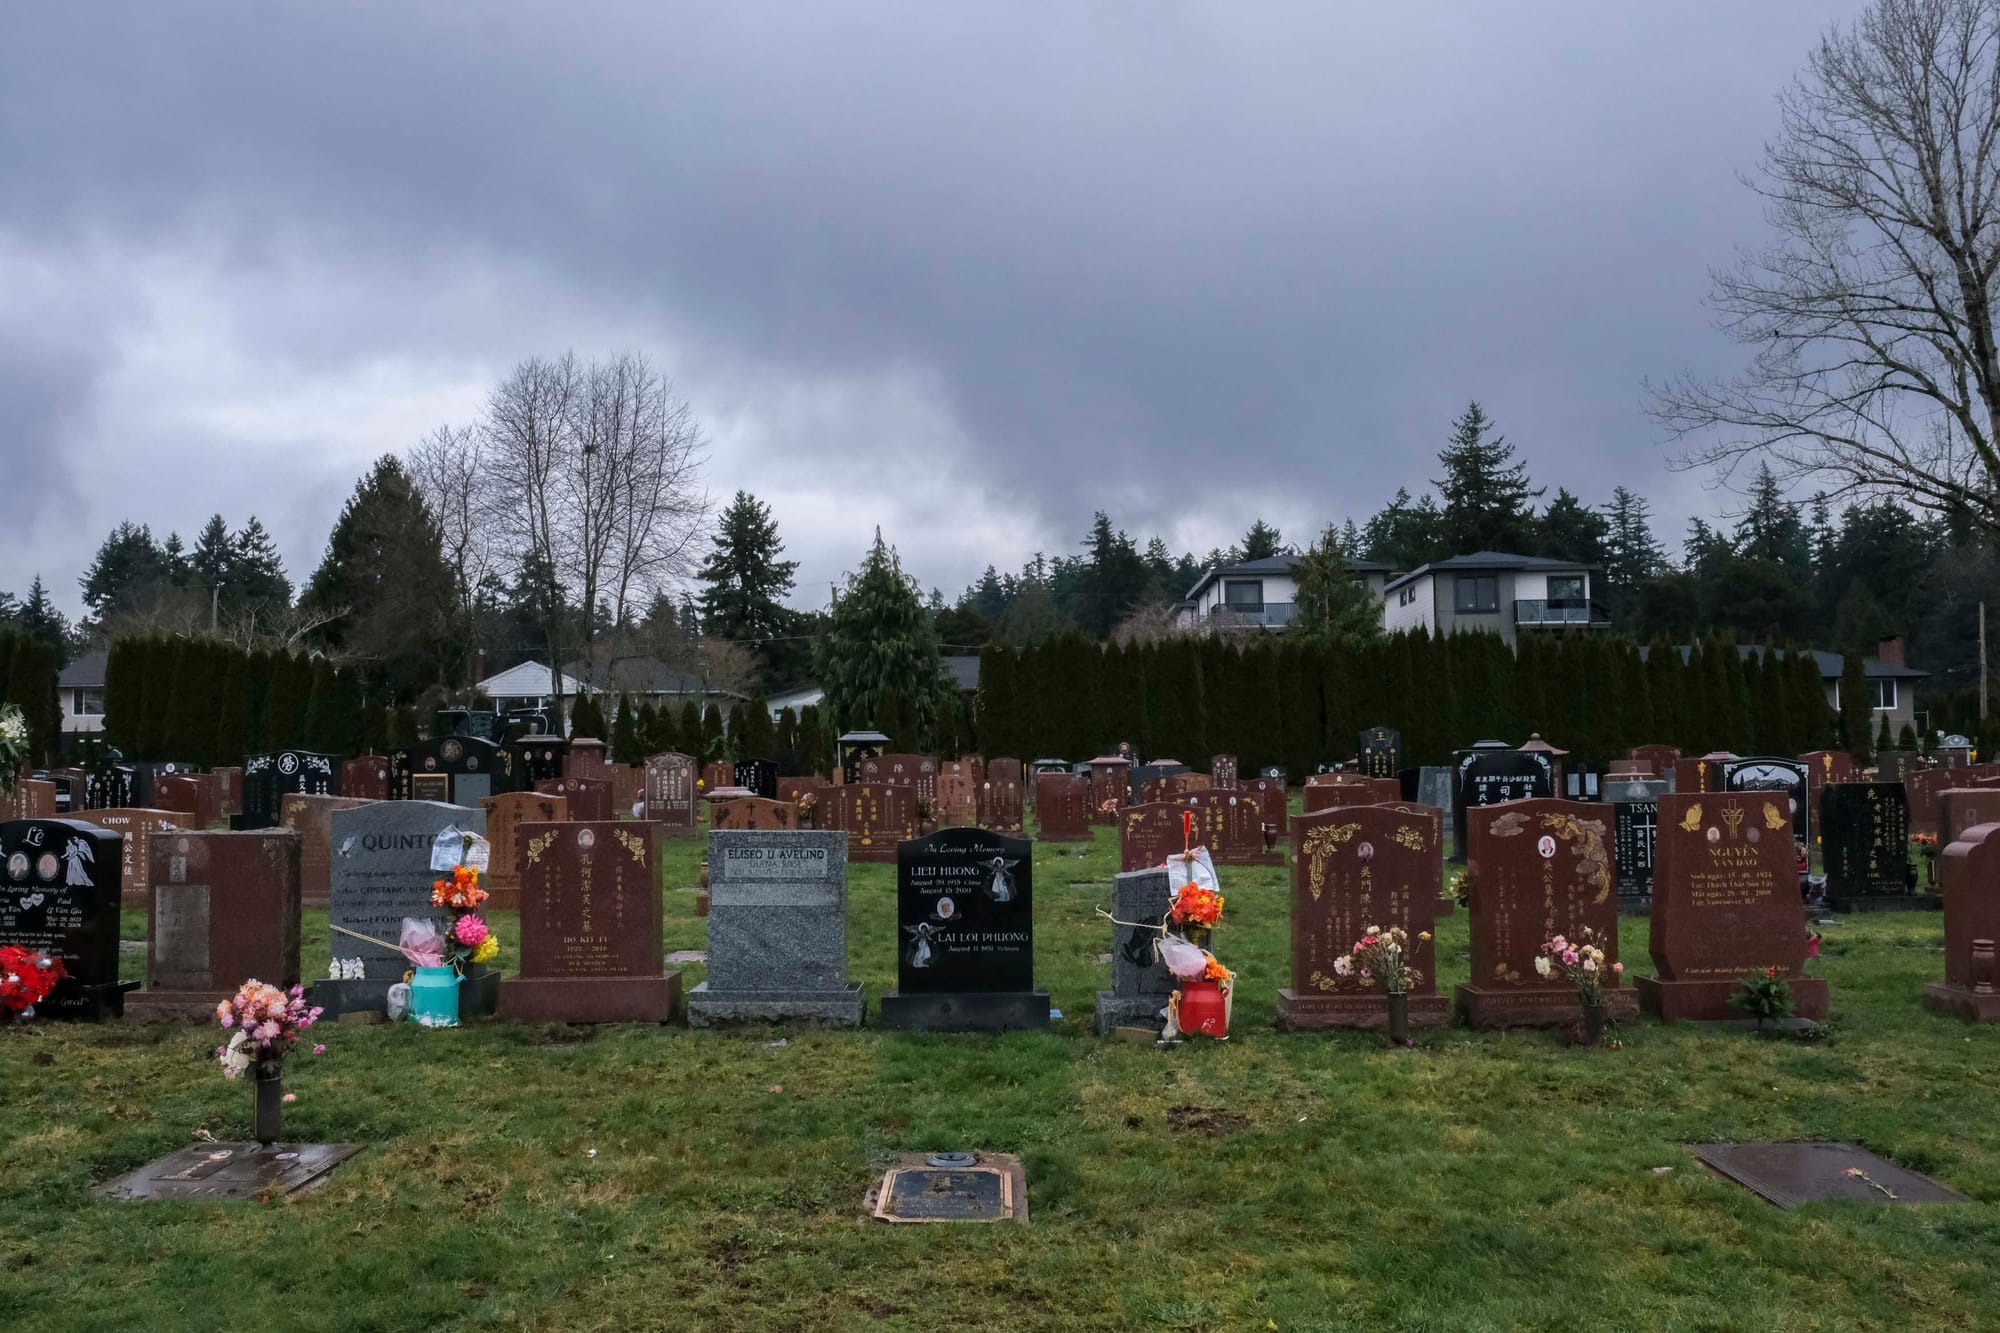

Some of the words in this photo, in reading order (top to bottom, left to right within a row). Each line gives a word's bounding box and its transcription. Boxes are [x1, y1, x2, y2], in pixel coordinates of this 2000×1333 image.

[102, 816, 131, 824] CHOW
[925, 843, 937, 853] In
[939, 843, 967, 855] Loving
[969, 843, 1004, 854] Memory
[728, 849, 763, 860] ELISEO
[779, 849, 825, 860] AVELINO
[911, 866, 936, 876] LIEU
[940, 866, 980, 876] HUONG
[938, 932, 956, 942] LAI
[960, 932, 978, 942] LOI
[982, 932, 1028, 942] PHUONG
